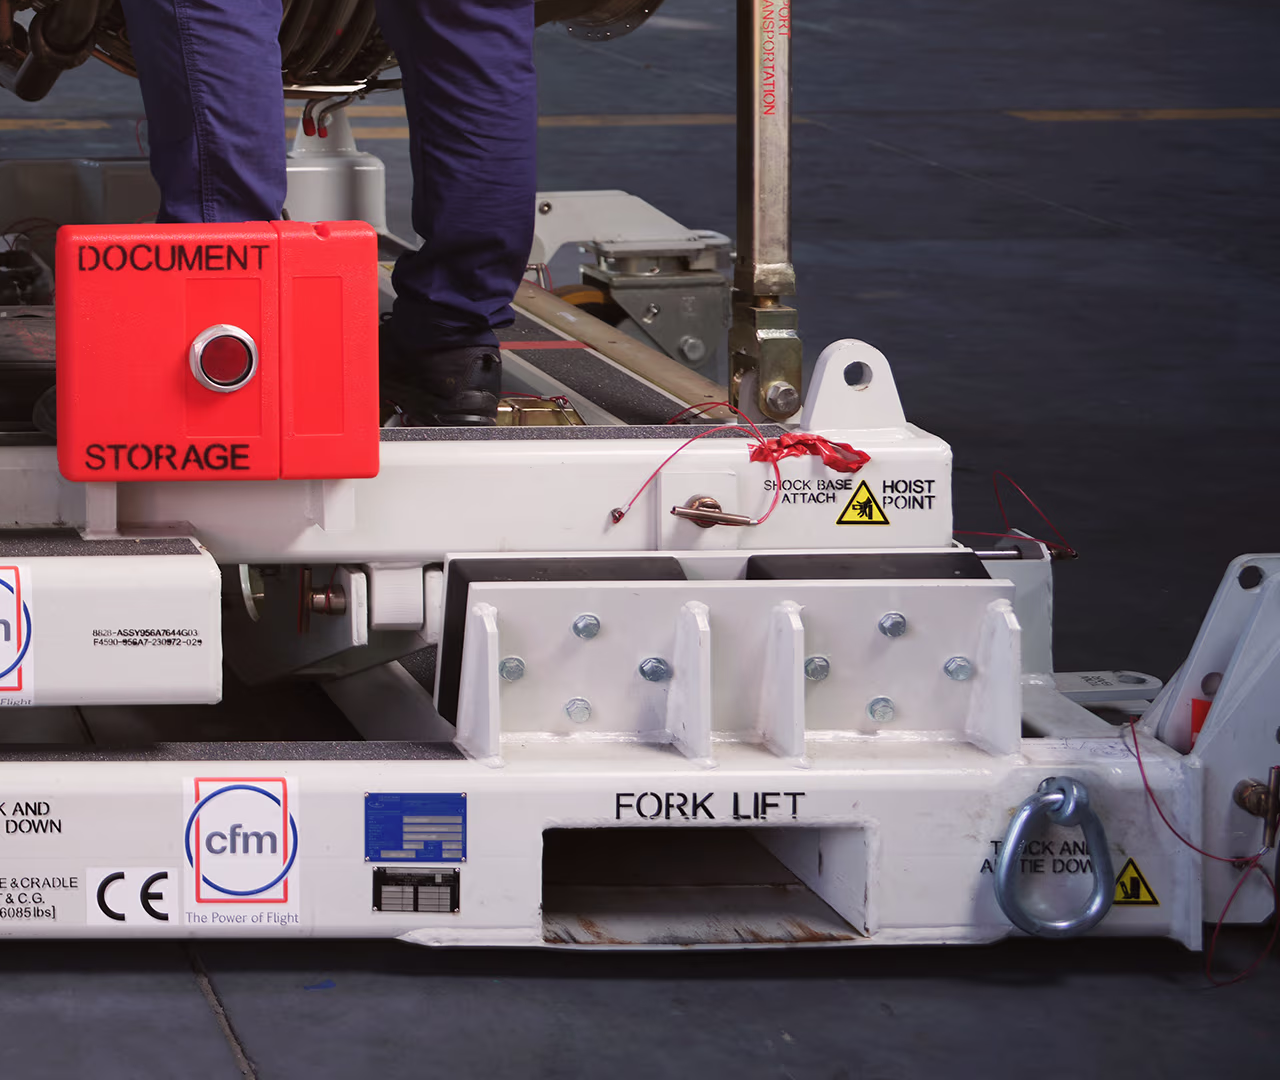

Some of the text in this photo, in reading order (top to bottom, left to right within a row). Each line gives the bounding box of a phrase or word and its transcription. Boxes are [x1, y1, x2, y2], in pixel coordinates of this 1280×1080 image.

[78, 244, 270, 272] DOCUMENT
[85, 443, 250, 471] STORAGE
[763, 479, 852, 492] SHOCK BASE
[883, 480, 935, 494] HOIST
[782, 492, 835, 503] ATTACH
[883, 495, 935, 510] POINT
[12, 802, 49, 816] AND
[616, 791, 806, 820] FORK LIFT
[6, 819, 61, 833] DOWN
[205, 825, 277, 855] cfm
[1060, 841, 1090, 855] AN
[1020, 859, 1092, 873] TIE DOW
[6, 893, 14, 904] &
[18, 893, 45, 904] C.G.
[186, 912, 299, 926] The Power of Flight
